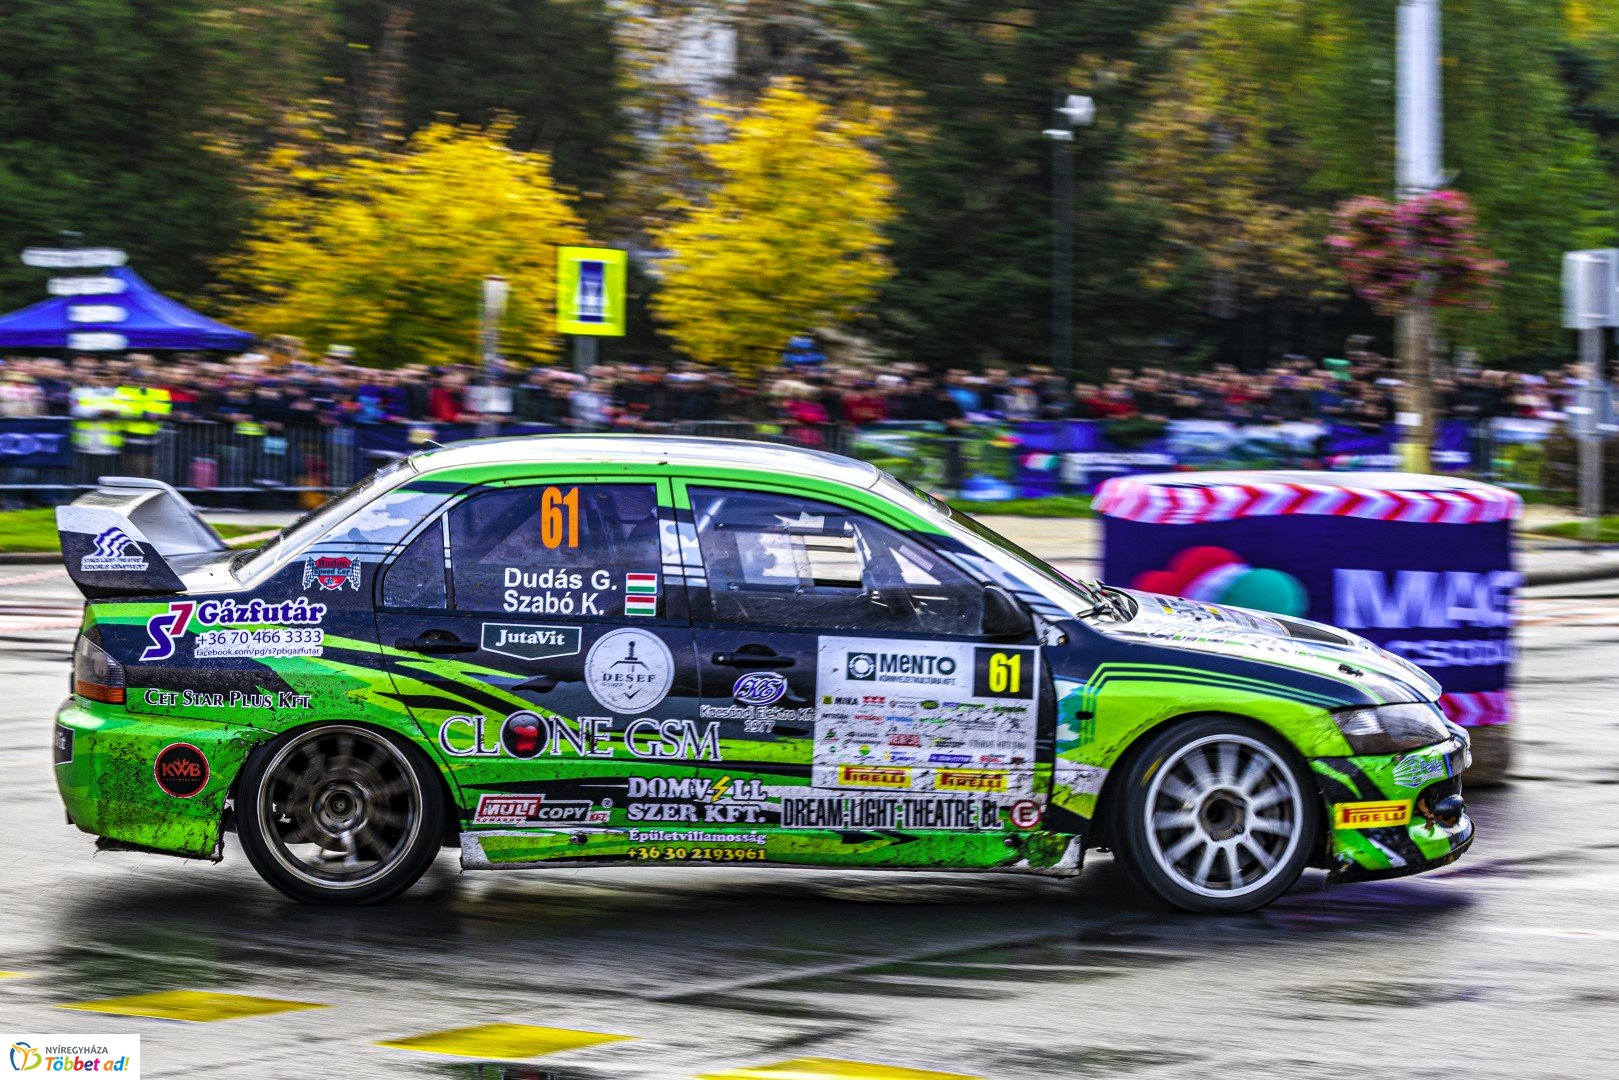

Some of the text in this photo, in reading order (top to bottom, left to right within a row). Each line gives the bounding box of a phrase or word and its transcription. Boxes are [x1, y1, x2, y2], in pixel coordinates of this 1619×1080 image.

[541, 486, 578, 550] 61
[504, 567, 618, 590] Dudás G.
[503, 589, 604, 615] Szabó K.
[198, 599, 324, 624] Gázfutár
[142, 602, 194, 659] S7
[197, 630, 321, 646] +36 70 466 3333
[495, 629, 565, 647] JutaVit
[196, 647, 321, 657] facebook.com/pg/s7pbgazfutar
[602, 673, 656, 683] DESEF
[989, 652, 1021, 693] 61
[744, 720, 775, 733] 1977
[439, 710, 722, 762] CLONE GSM
[162, 758, 201, 777] KWB
[843, 766, 906, 784] PIRELLI
[940, 771, 1003, 788] PIRELLI
[482, 799, 537, 816] MULTI
[538, 807, 585, 819] COPY
[627, 803, 766, 824] SZER KFT.
[1342, 805, 1407, 823] PIRELLI
[628, 828, 767, 844] Épületvillamosság
[627, 847, 766, 861] +36 30 2193961
